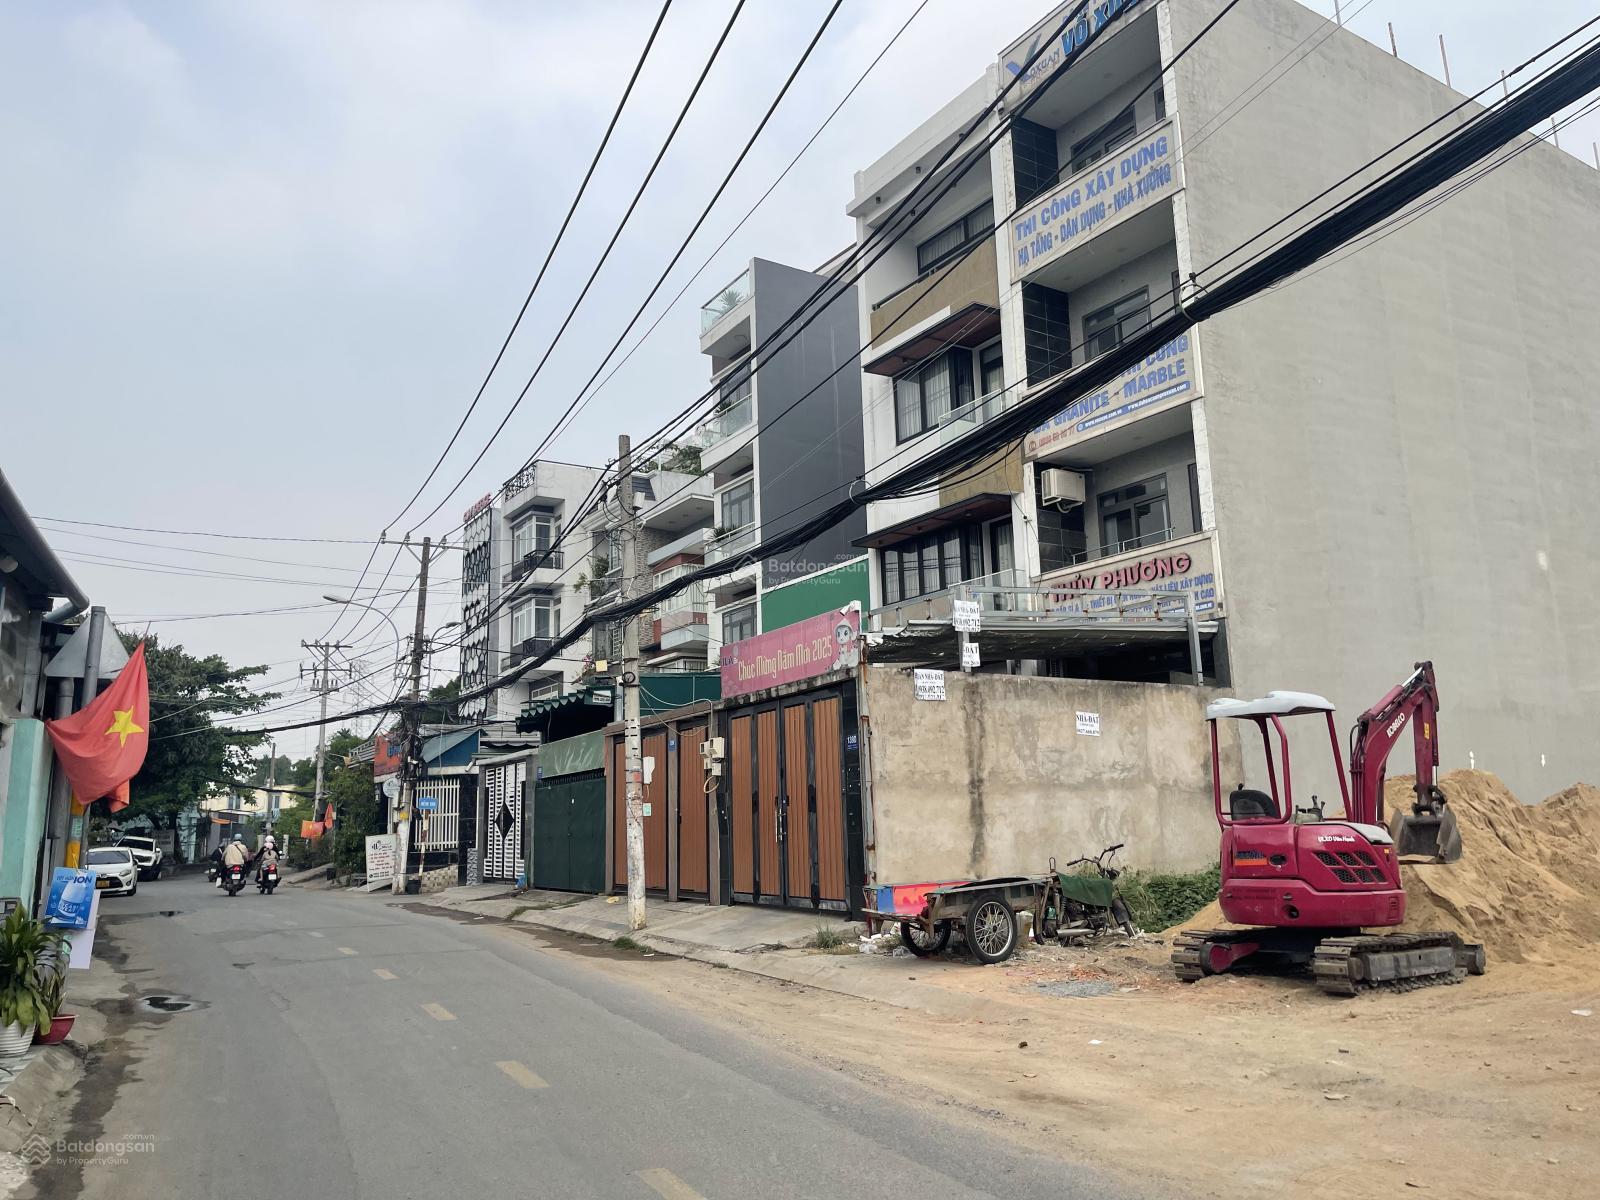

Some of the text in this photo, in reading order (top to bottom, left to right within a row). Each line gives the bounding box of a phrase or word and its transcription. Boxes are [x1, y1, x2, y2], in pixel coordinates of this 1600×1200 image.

[1015, 136, 1168, 241] THI CÔNG XÂY DỰNG
[1018, 245, 1029, 267] HẠ
[1030, 231, 1053, 258] TẦNG
[1060, 218, 1078, 243] DÂN
[1113, 182, 1134, 212] NHÀ
[1136, 163, 1172, 198] XƯỞNG
[1124, 358, 1186, 399] MARBLE
[1049, 552, 1192, 602] THỦY PHƯƠNG
[1180, 577, 1192, 589] XÂY
[1194, 573, 1213, 588] DỰNG
[738, 635, 832, 681] Chúc Mừng Năm Mới 2025
[73, 875, 92, 884] ION
